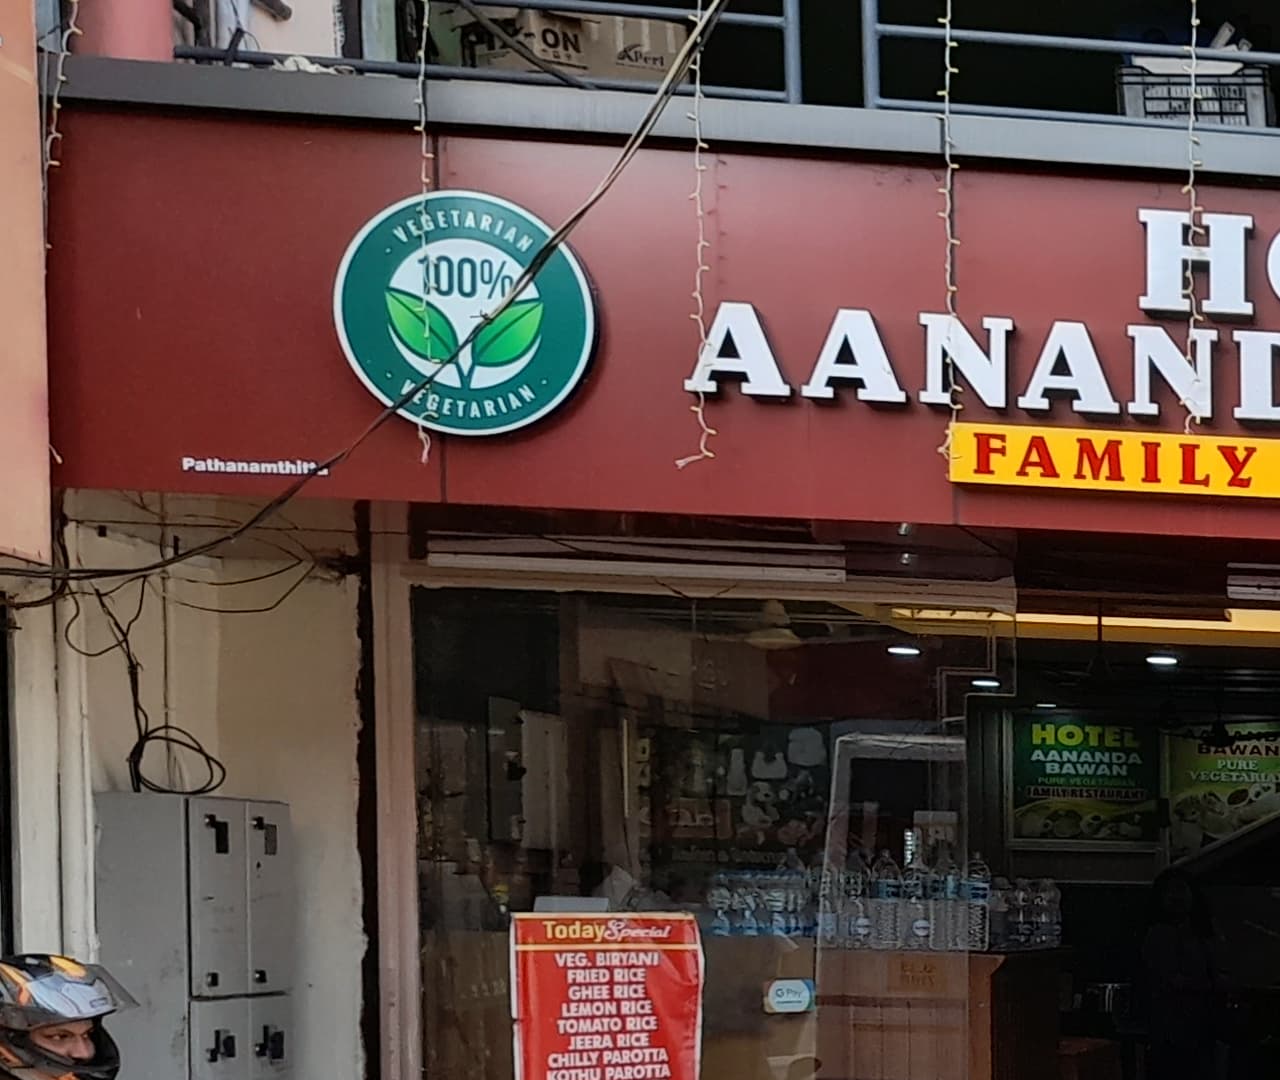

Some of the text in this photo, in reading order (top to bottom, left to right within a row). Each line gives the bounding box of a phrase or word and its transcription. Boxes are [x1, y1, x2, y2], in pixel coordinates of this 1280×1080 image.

[392, 209, 534, 252] VEGETARIAN
[417, 254, 515, 299] 100%
[971, 431, 1258, 489] FAMILY
[1031, 722, 1140, 748] HOTEL
[1030, 749, 1145, 765] AANANDA
[1218, 759, 1259, 771] PURE
[1045, 762, 1129, 777] BAWAN
[543, 919, 672, 942] Today Special
[555, 951, 660, 967] VEG. BIRYANI
[567, 967, 646, 984] FRIED RICE
[568, 984, 646, 1001] GHEE RICE
[561, 1000, 653, 1018] LEMON RICE
[557, 1016, 658, 1034] TOMATO RICE
[568, 1032, 650, 1050] JEERA RICE
[548, 1048, 669, 1068] CHILLY PAROTTA
[604, 1064, 671, 1080] PAROTTA
